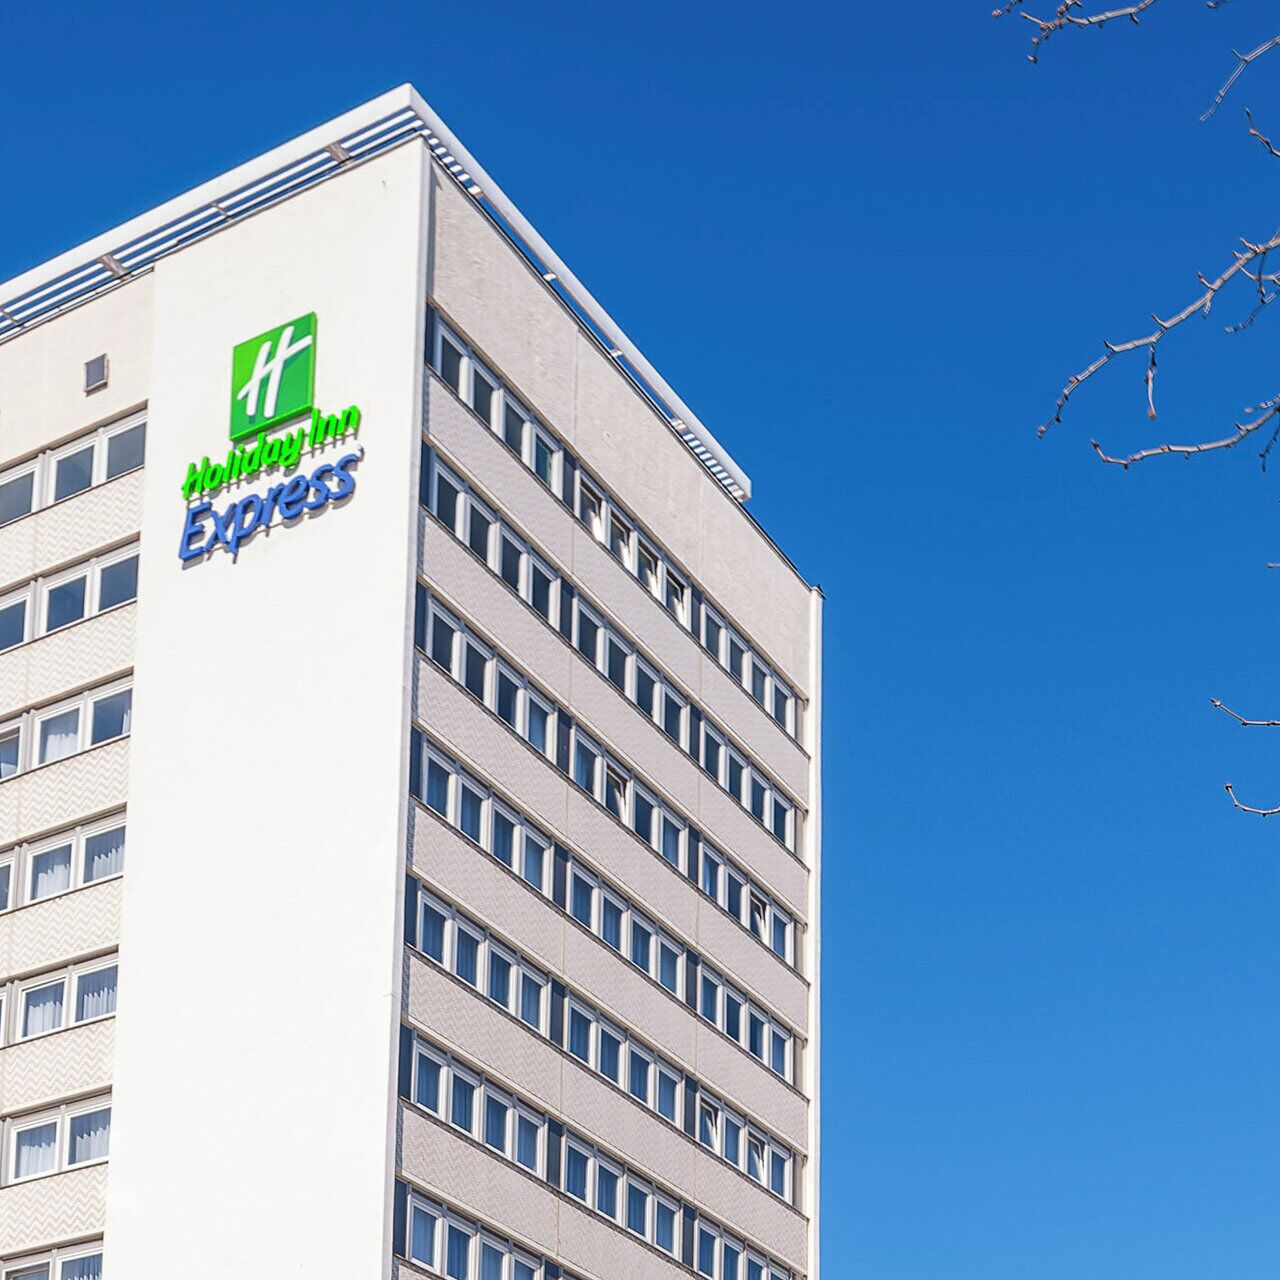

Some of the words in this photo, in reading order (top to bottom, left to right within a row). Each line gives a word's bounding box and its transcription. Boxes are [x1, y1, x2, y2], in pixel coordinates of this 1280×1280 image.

[181, 424, 306, 500] Holiday
[307, 404, 362, 447] Inn
[178, 453, 358, 562] Express
